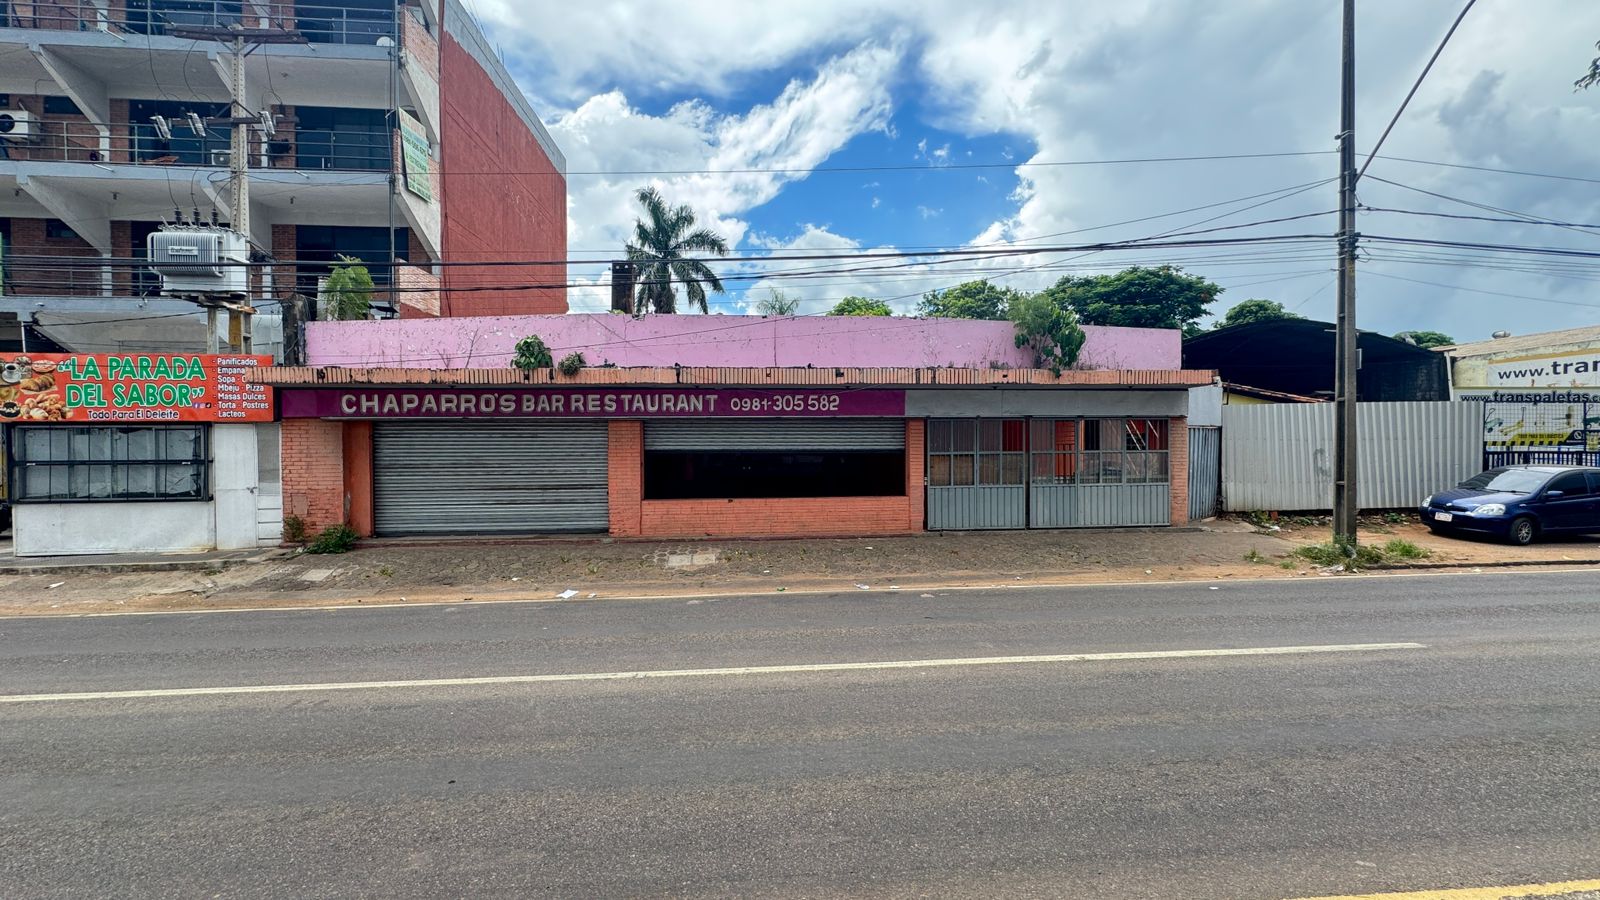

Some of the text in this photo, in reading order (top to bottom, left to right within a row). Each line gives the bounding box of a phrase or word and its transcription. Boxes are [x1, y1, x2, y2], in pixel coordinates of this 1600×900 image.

[217, 357, 258, 366] Panificados
[107, 356, 207, 380] PARADA
[217, 375, 236, 384] Sopa
[217, 384, 240, 392] Mbeju
[66, 382, 108, 408] DEL
[242, 392, 266, 400] Dulces
[1460, 391, 1600, 402] www.transpaletas.c
[242, 401, 269, 409] Postres
[341, 393, 516, 413] CHAPARRO'S
[522, 394, 564, 412] BAR
[570, 394, 718, 412] RESTAURANT
[88, 410, 179, 419] Todo Para El Deleite
